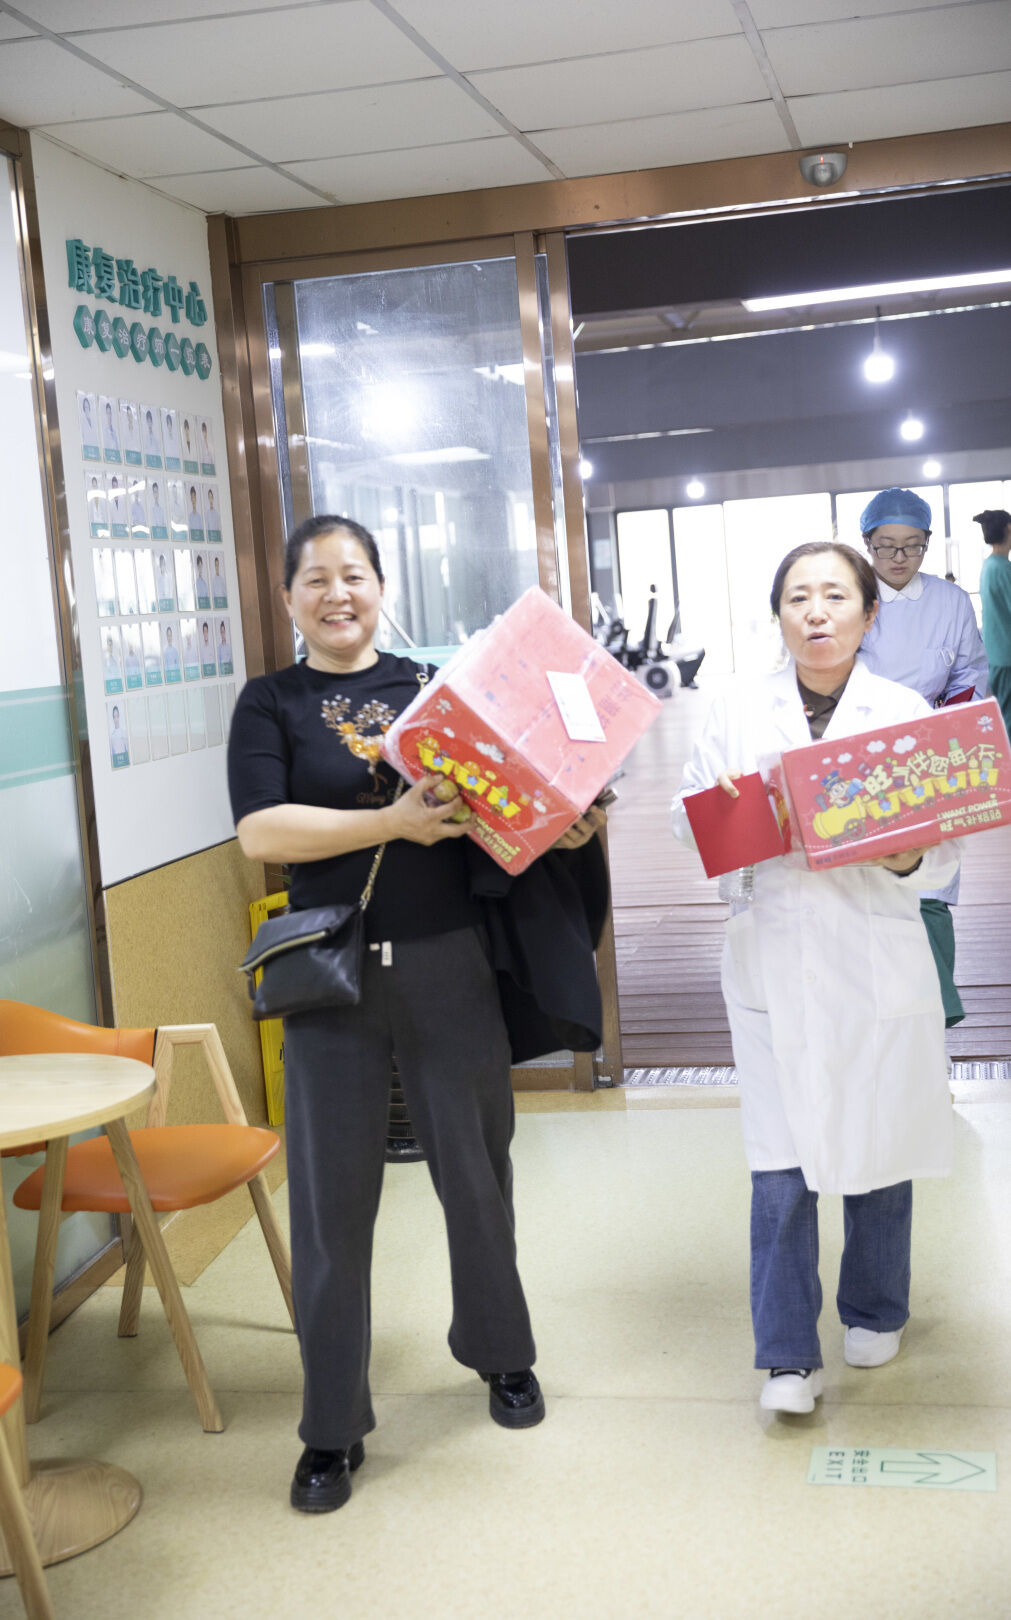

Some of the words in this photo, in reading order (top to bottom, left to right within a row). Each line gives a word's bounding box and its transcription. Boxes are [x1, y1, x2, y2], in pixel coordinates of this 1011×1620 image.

[66, 239, 208, 327] 康复治疗中心
[83, 315, 212, 370] 康复治疗师一览表
[941, 806, 967, 820] WANT
[967, 799, 998, 814] POWER
[825, 1451, 845, 1478] EXIT
